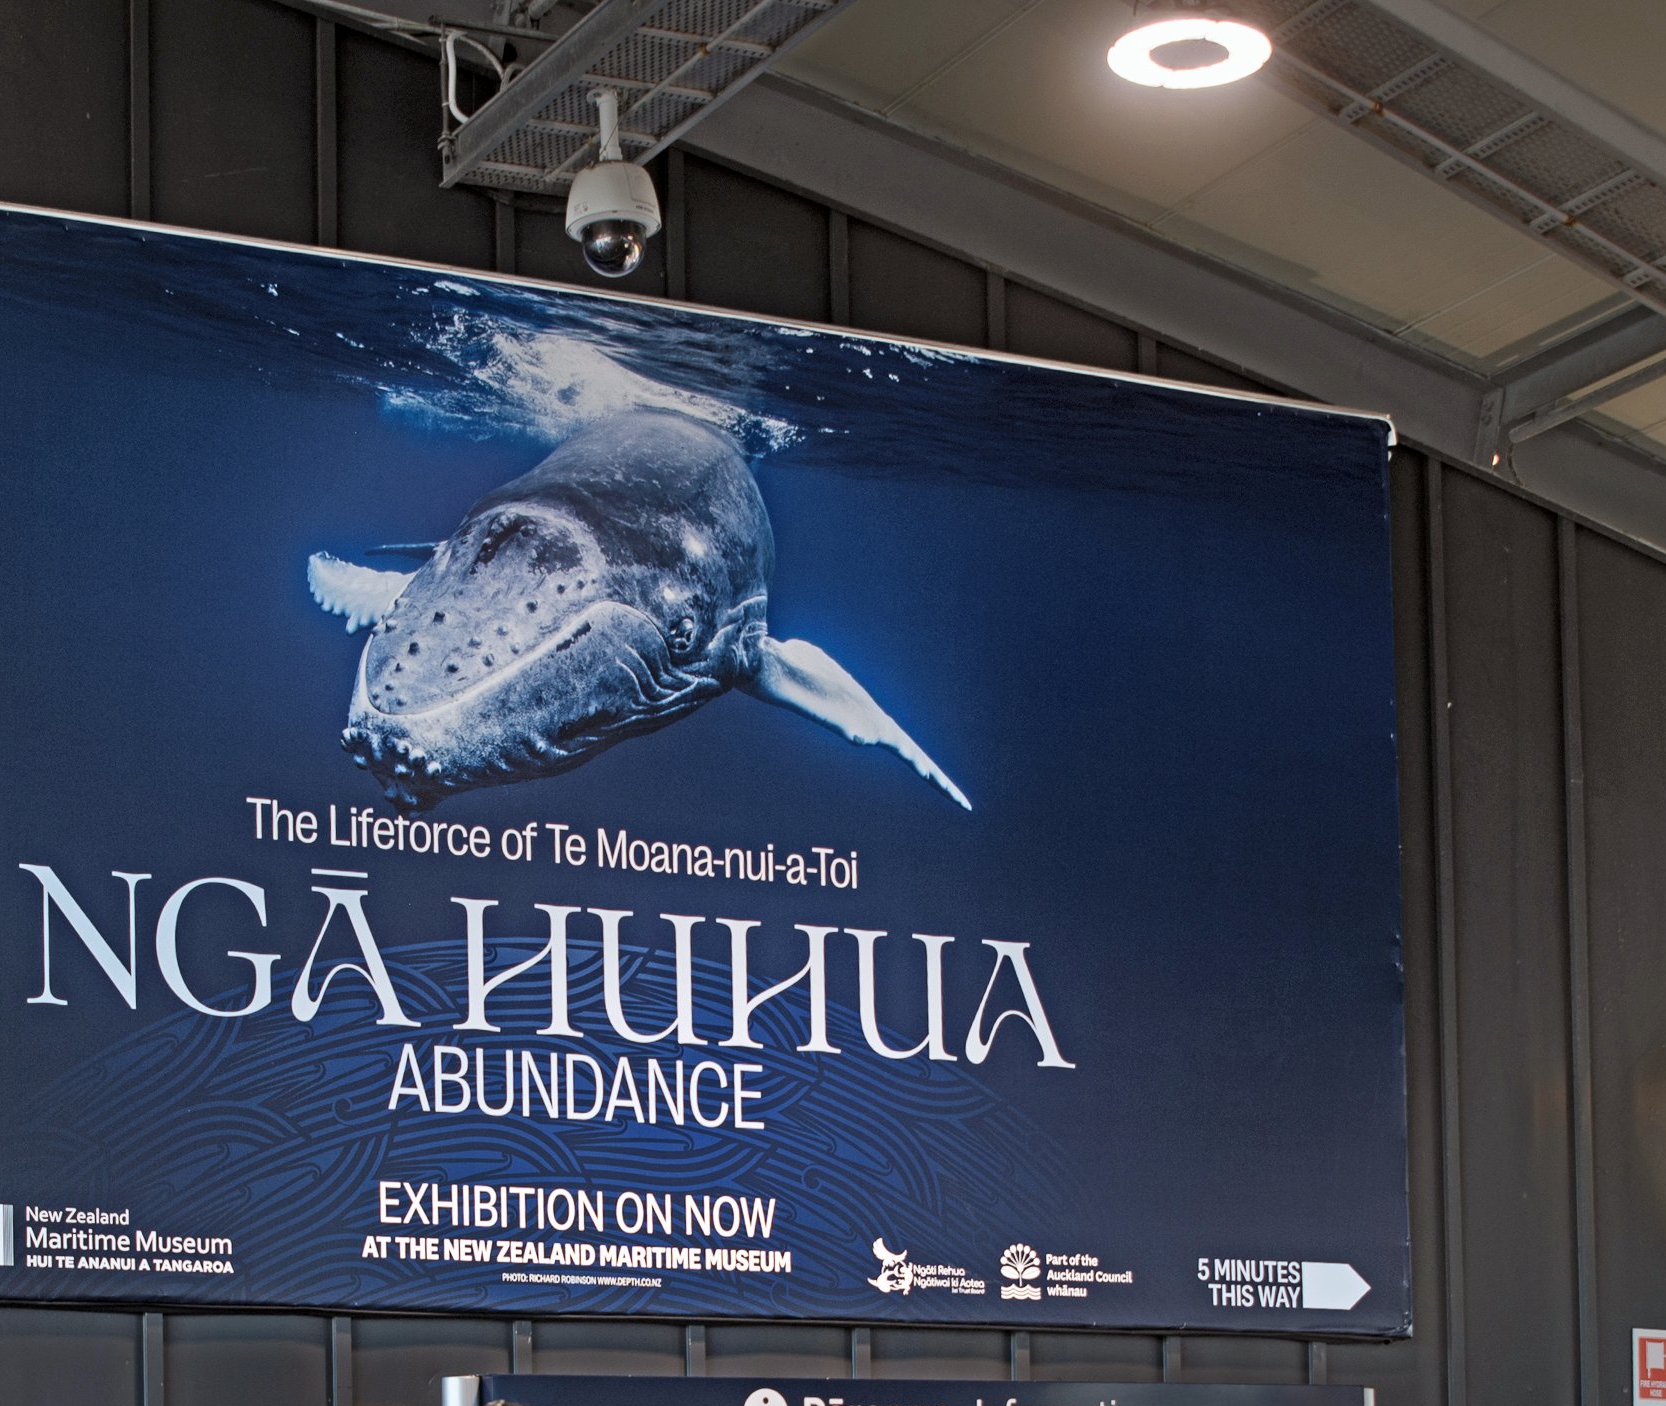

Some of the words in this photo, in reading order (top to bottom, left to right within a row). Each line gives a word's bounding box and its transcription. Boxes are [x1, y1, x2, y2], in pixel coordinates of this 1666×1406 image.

[246, 796, 318, 844] The
[501, 821, 538, 862] of
[545, 823, 587, 866] Te
[598, 828, 859, 889] Moana-nui-a-Toi
[19, 862, 421, 1030] NGĀ
[451, 895, 1077, 1070] HUHUA
[388, 1043, 766, 1131] ABUNDANCE
[25, 1206, 63, 1223] New
[65, 1207, 130, 1226] Zealand
[379, 1180, 604, 1233] EXHIBITION
[615, 1191, 672, 1235] ON
[685, 1195, 776, 1239] NOW
[25, 1226, 131, 1251] Maritime
[135, 1230, 233, 1255] Museum
[26, 1255, 53, 1268] HUI
[55, 1256, 75, 1269] TE
[77, 1256, 136, 1271] ANANUI
[138, 1258, 151, 1271] A
[153, 1259, 234, 1274] TANGAROA
[362, 1235, 391, 1260] AT
[395, 1236, 440, 1262] THE
[444, 1238, 493, 1263] NEW
[497, 1241, 596, 1268] ZEALAND
[599, 1244, 701, 1271] MARITIME
[705, 1248, 792, 1273] MUSEUM
[1045, 1253, 1068, 1266] Part
[1068, 1253, 1081, 1266] of
[1081, 1253, 1099, 1267] the
[502, 1273, 529, 1283] PHOTO:
[529, 1273, 561, 1284] RICHARD
[561, 1275, 597, 1286] ROBINSON
[597, 1276, 662, 1288] WWW.DEPTH.CO.NZ
[937, 1265, 966, 1277] Rehua
[1046, 1269, 1094, 1282] Auckland
[1095, 1270, 1133, 1284] Council
[1197, 1258, 1210, 1281] 5
[1214, 1259, 1301, 1284] MINUTES
[951, 1277, 960, 1288] ki
[960, 1278, 985, 1289] Aotea
[1046, 1284, 1087, 1297] whānau
[1208, 1283, 1254, 1307] THIS
[1257, 1285, 1301, 1308] WAY
